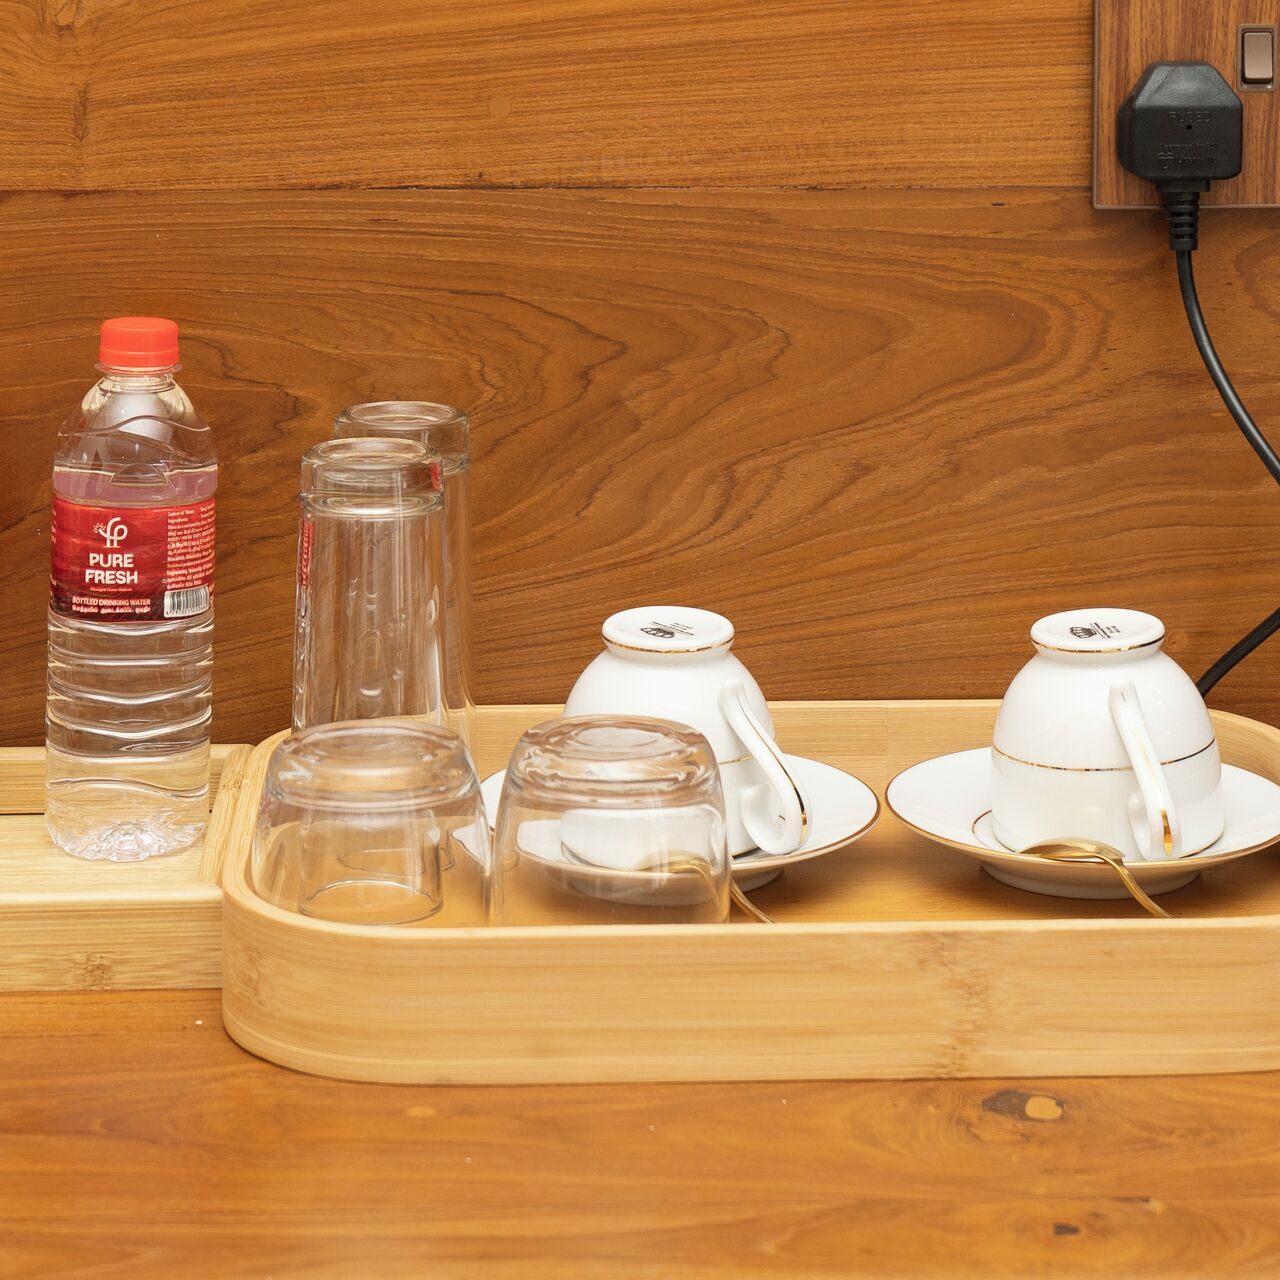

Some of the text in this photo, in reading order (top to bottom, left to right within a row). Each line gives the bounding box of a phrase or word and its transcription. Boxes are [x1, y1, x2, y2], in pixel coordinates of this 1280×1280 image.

[89, 553, 134, 568] PURE
[85, 569, 138, 584] FRESH
[72, 596, 99, 606] BOTTLED
[129, 598, 151, 606] WATER
